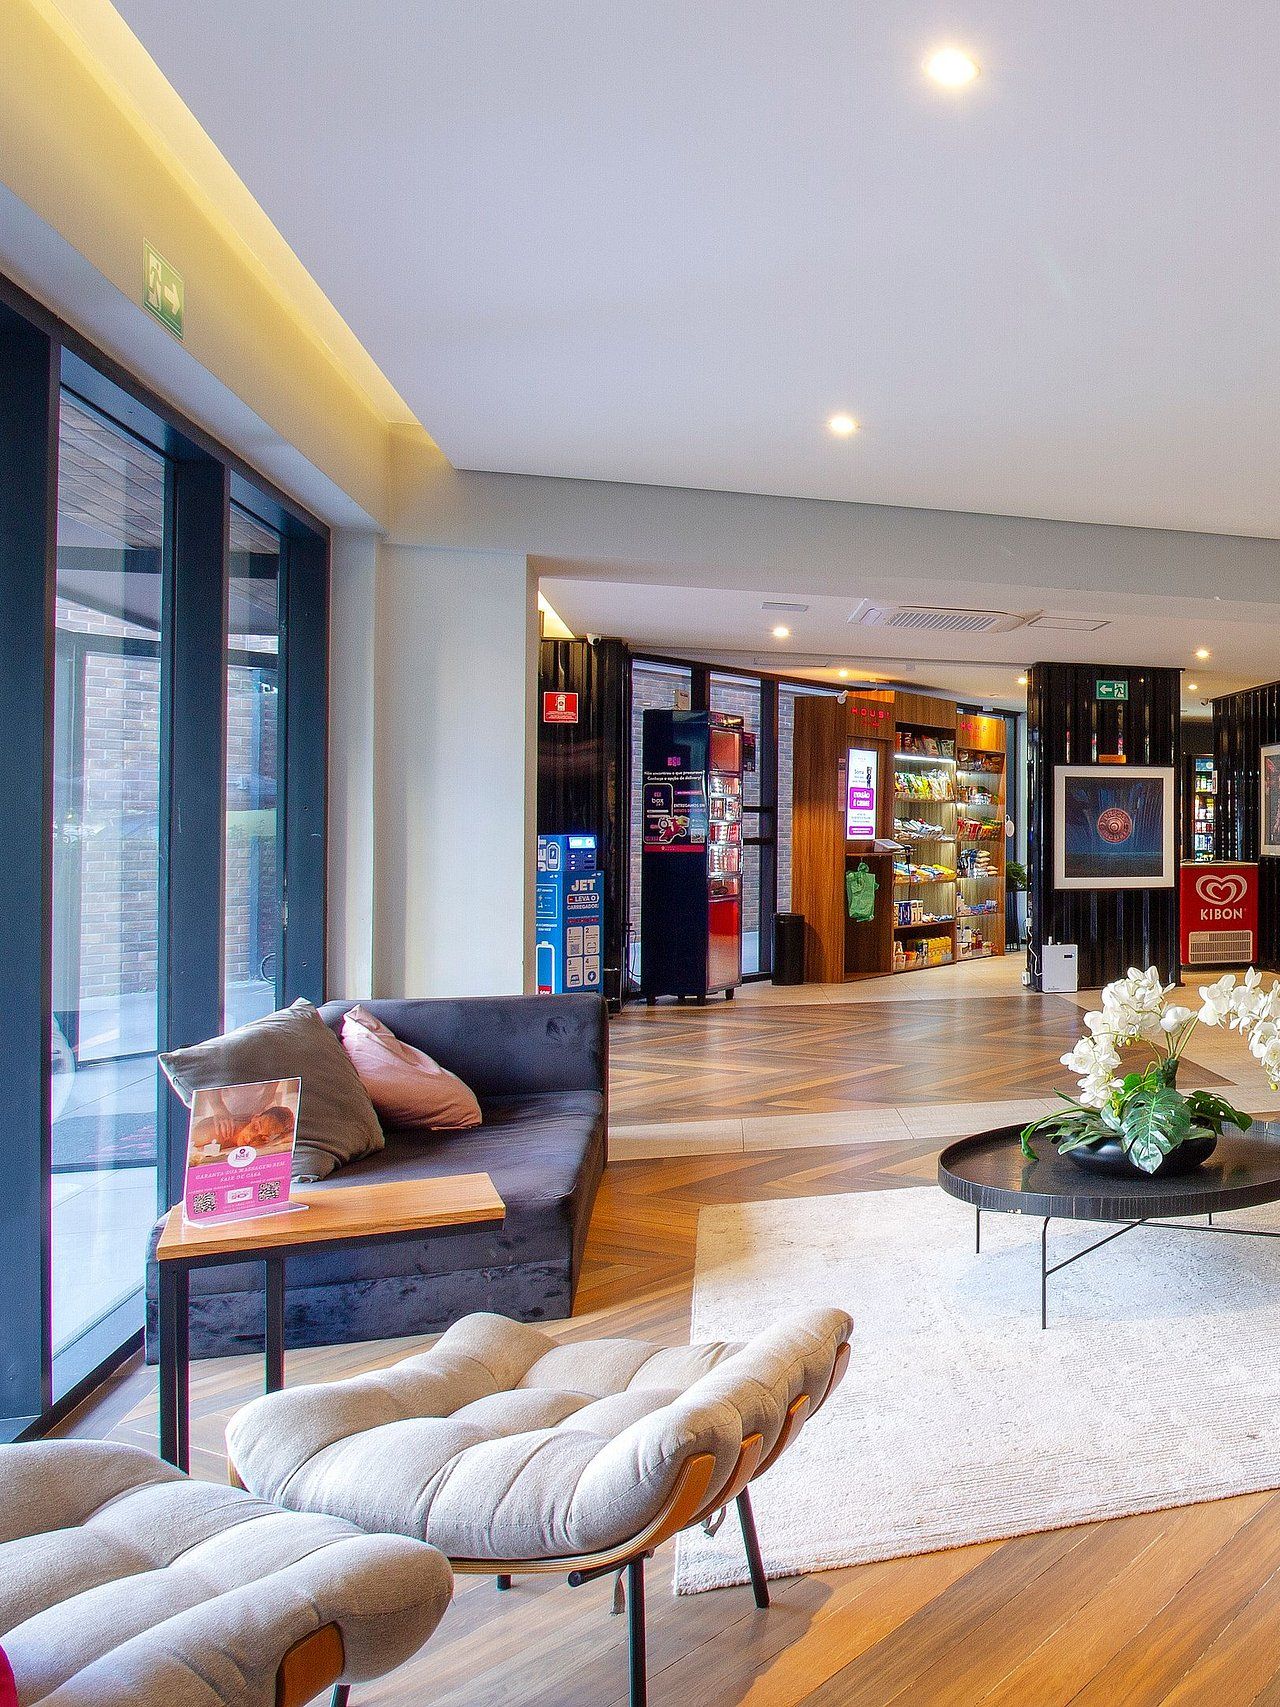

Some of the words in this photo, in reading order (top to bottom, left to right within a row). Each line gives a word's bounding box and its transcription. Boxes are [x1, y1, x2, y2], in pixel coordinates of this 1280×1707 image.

[571, 879, 596, 892] JET
[574, 895, 591, 903] LEVA
[1200, 908, 1243, 921] KIBON
